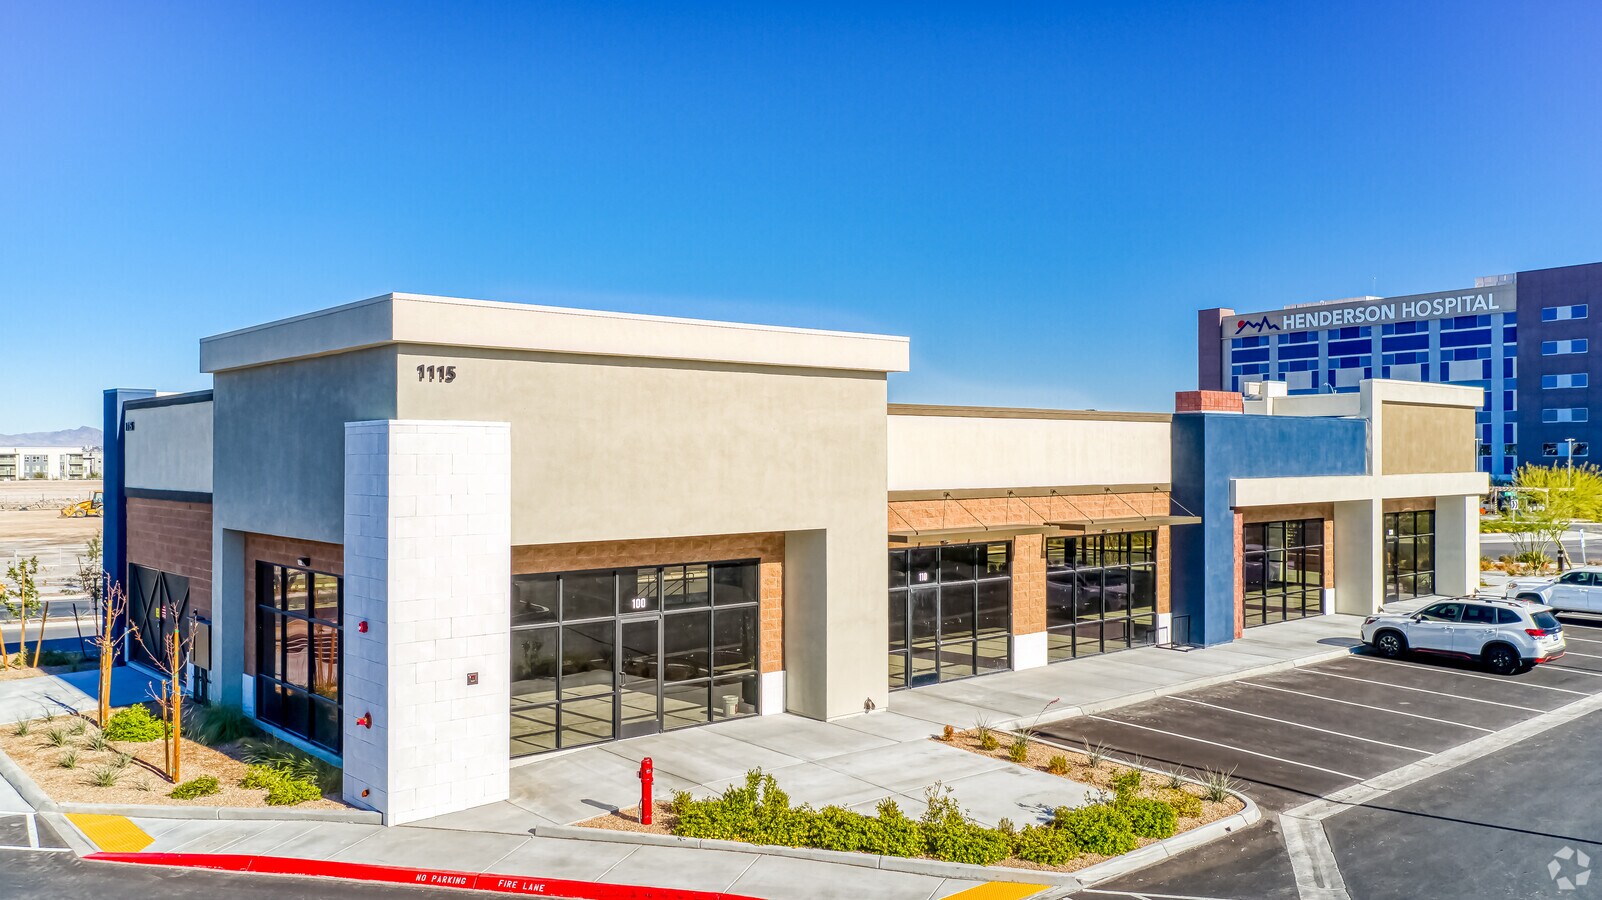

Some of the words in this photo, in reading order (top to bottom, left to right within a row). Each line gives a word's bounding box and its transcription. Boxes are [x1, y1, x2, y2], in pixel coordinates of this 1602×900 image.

[1283, 304, 1395, 330] HENDERSON
[1402, 293, 1499, 318] HOSPITAL
[416, 364, 457, 383] 1115
[632, 598, 646, 609] 100
[415, 873, 427, 882] NO
[431, 875, 467, 885] PARKING
[498, 879, 518, 889] FIRE
[522, 881, 546, 892] LANE
